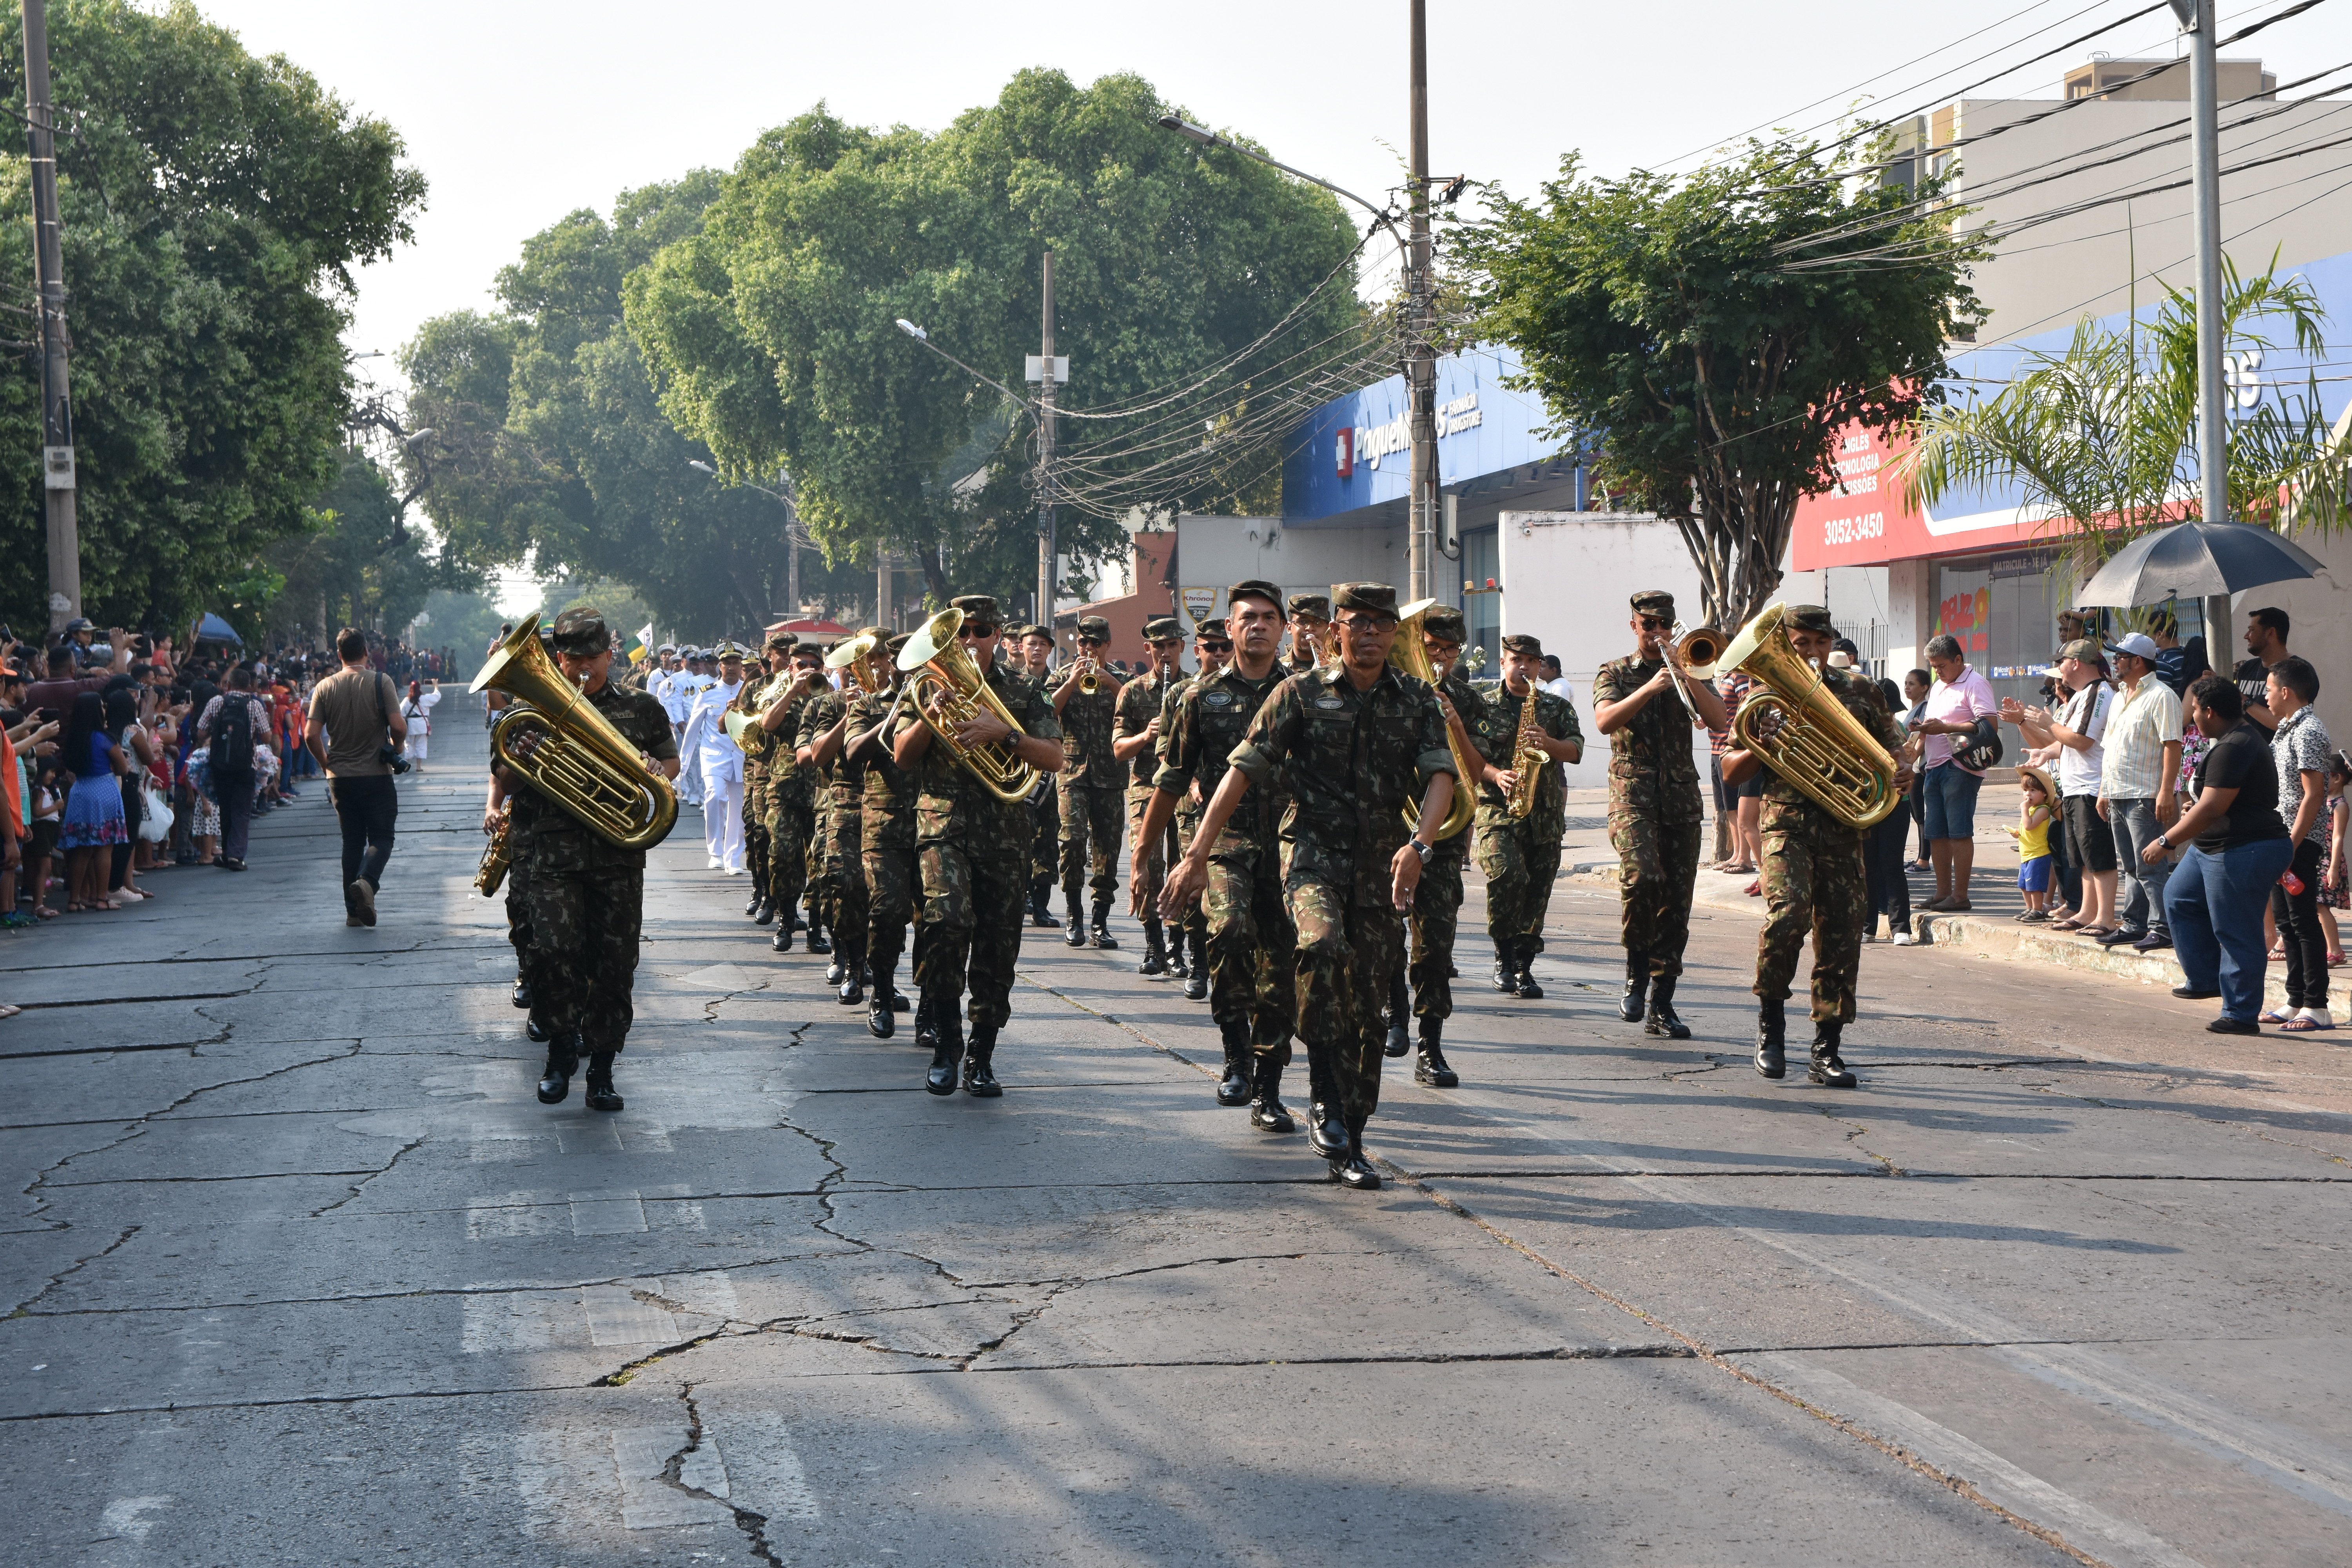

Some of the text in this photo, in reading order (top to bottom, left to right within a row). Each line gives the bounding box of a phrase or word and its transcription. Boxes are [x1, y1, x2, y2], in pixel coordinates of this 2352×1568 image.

[1449, 392, 1478, 416] FARMÁCIA
[1448, 410, 1482, 434] DRUGSTORE
[1824, 511, 1883, 545] 3052-3450
[1993, 558, 2027, 572] MATRICULE
[2041, 553, 2047, 568] JÁ
[2094, 699, 2103, 719] Sicredi
